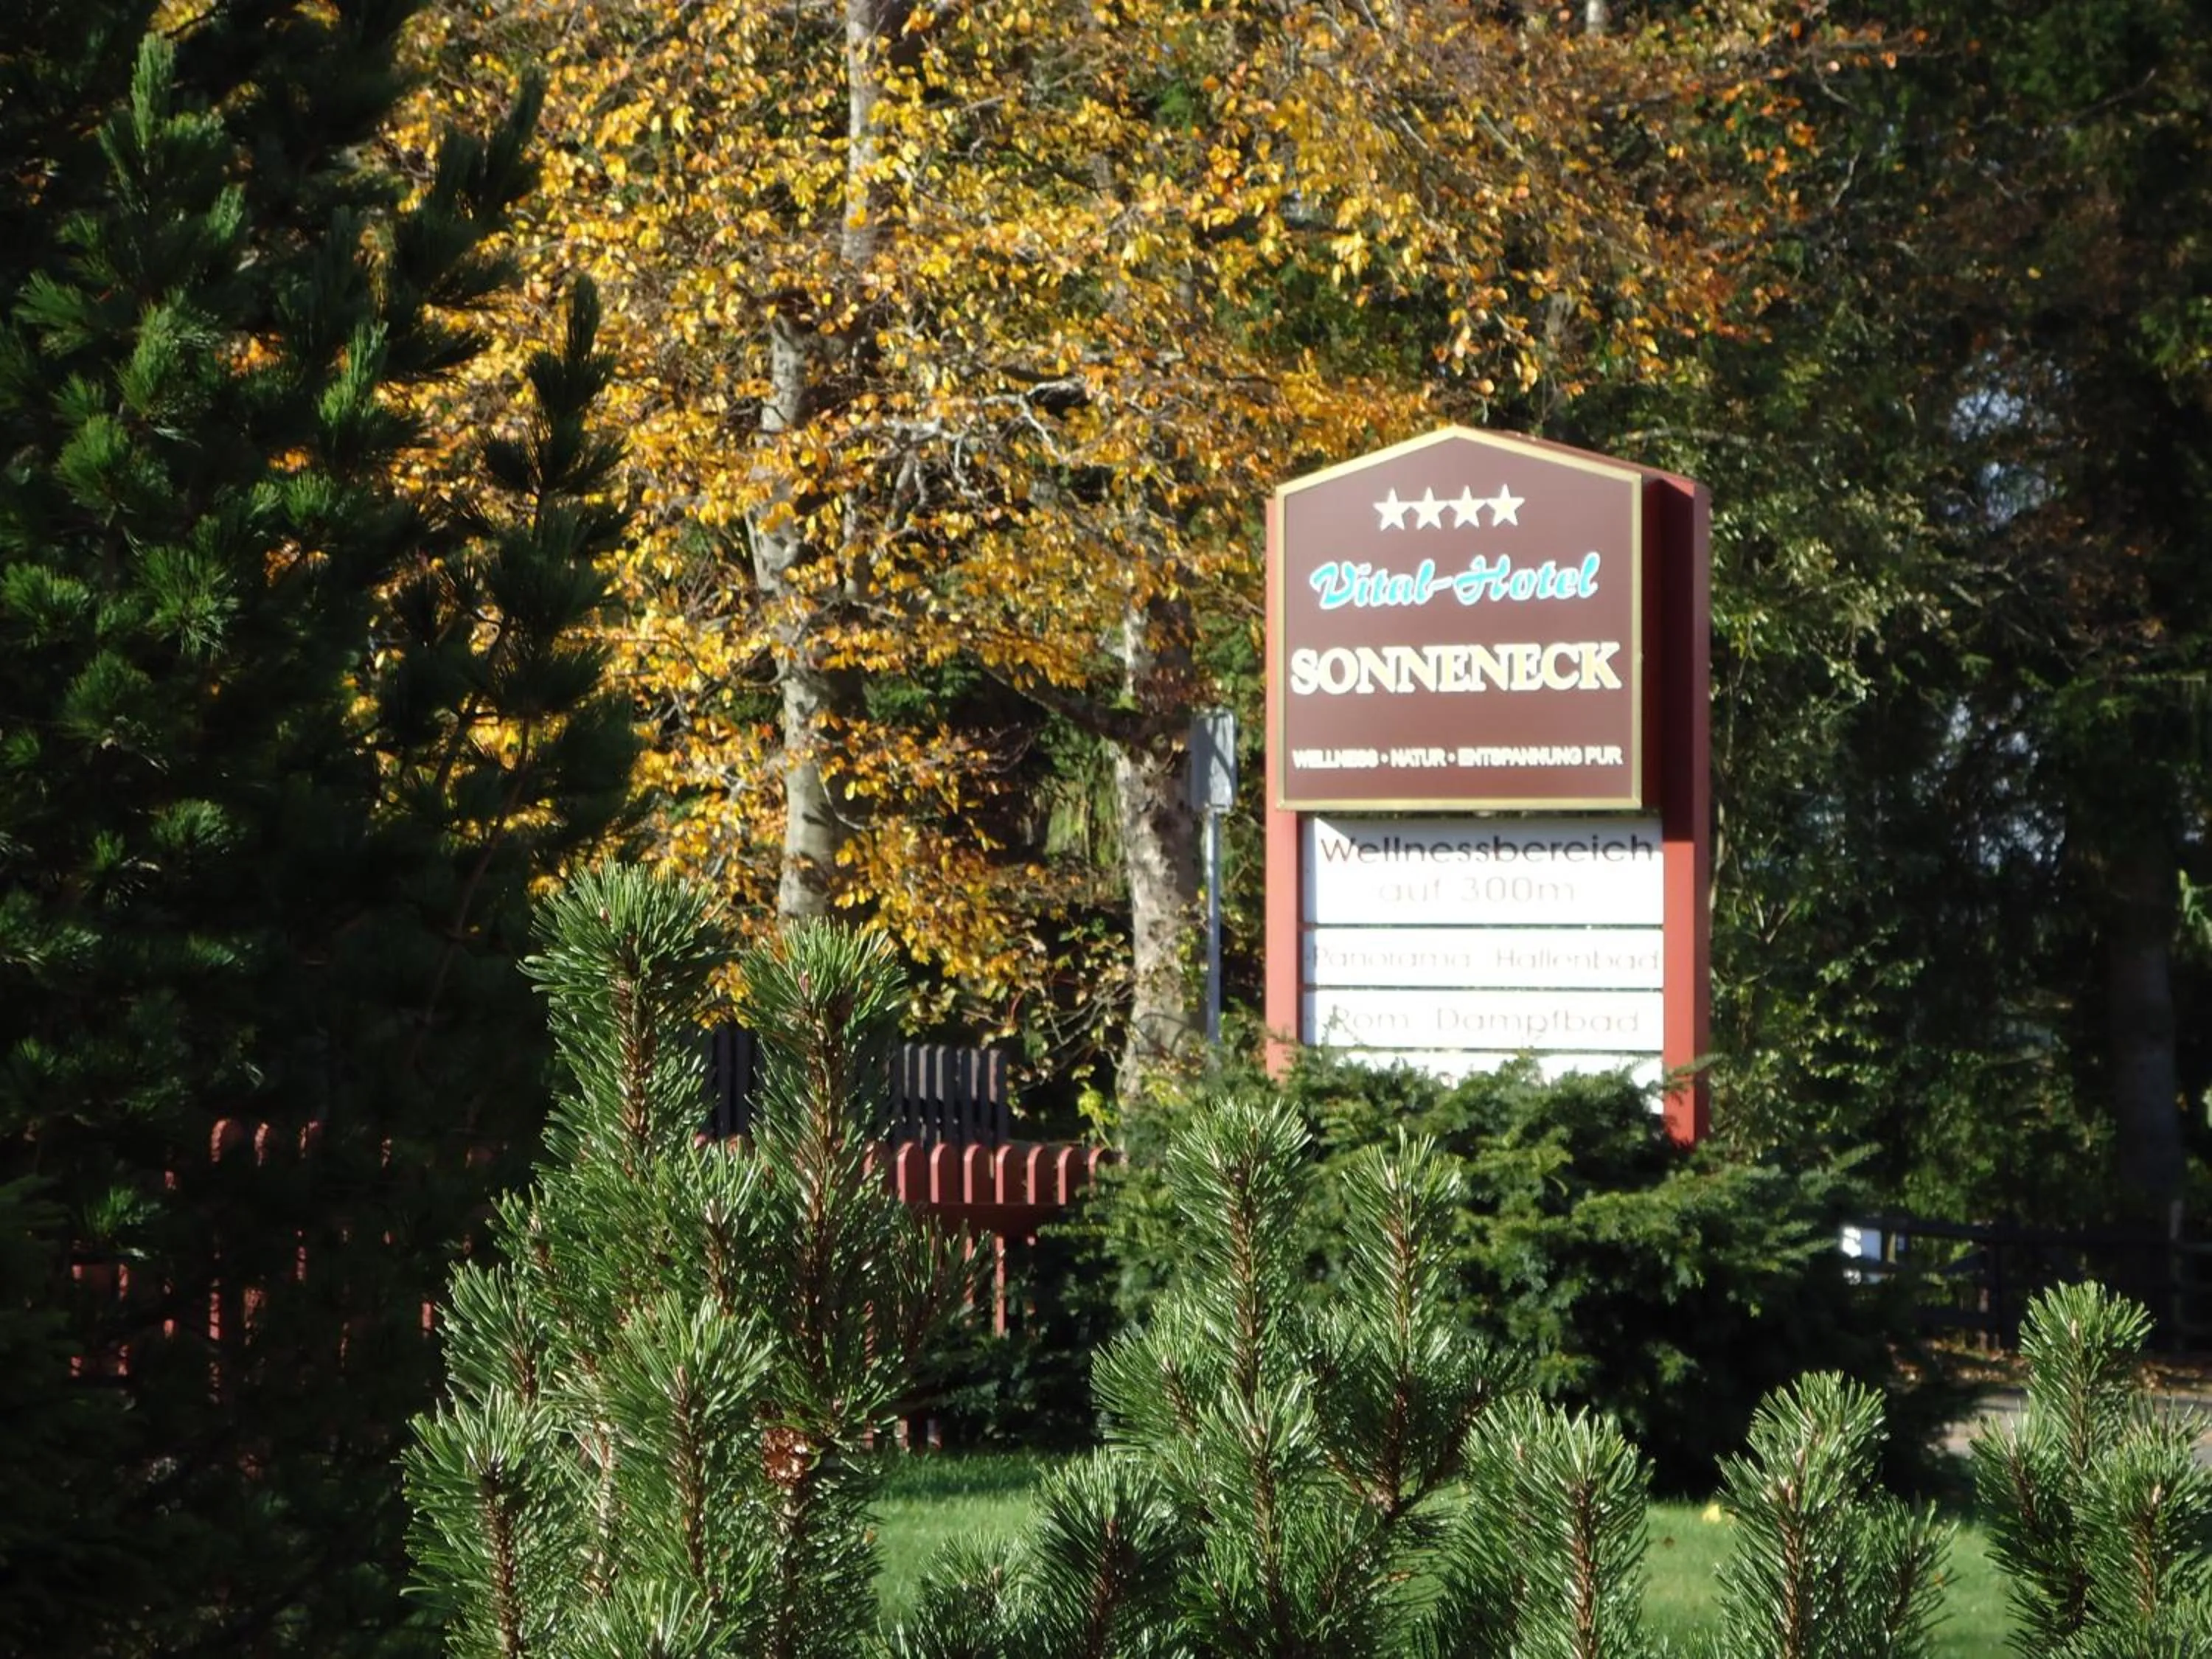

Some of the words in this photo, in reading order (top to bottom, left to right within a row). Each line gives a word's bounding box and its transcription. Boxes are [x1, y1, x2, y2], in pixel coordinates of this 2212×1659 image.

[1310, 552, 1600, 609] Vital-Hotel
[1290, 641, 1621, 695] SONNENECK
[1292, 748, 1379, 769] WELLNESS
[1390, 747, 1448, 768] NATUR
[1585, 745, 1623, 765] PUR
[1320, 834, 1655, 863] Wellnessbereich
[1377, 876, 1442, 904] auf
[1459, 875, 1576, 904] 300m
[1313, 945, 1472, 970] Panorama
[1495, 946, 1660, 971] Hallenbad
[1436, 1006, 1640, 1037] Dampfbad
